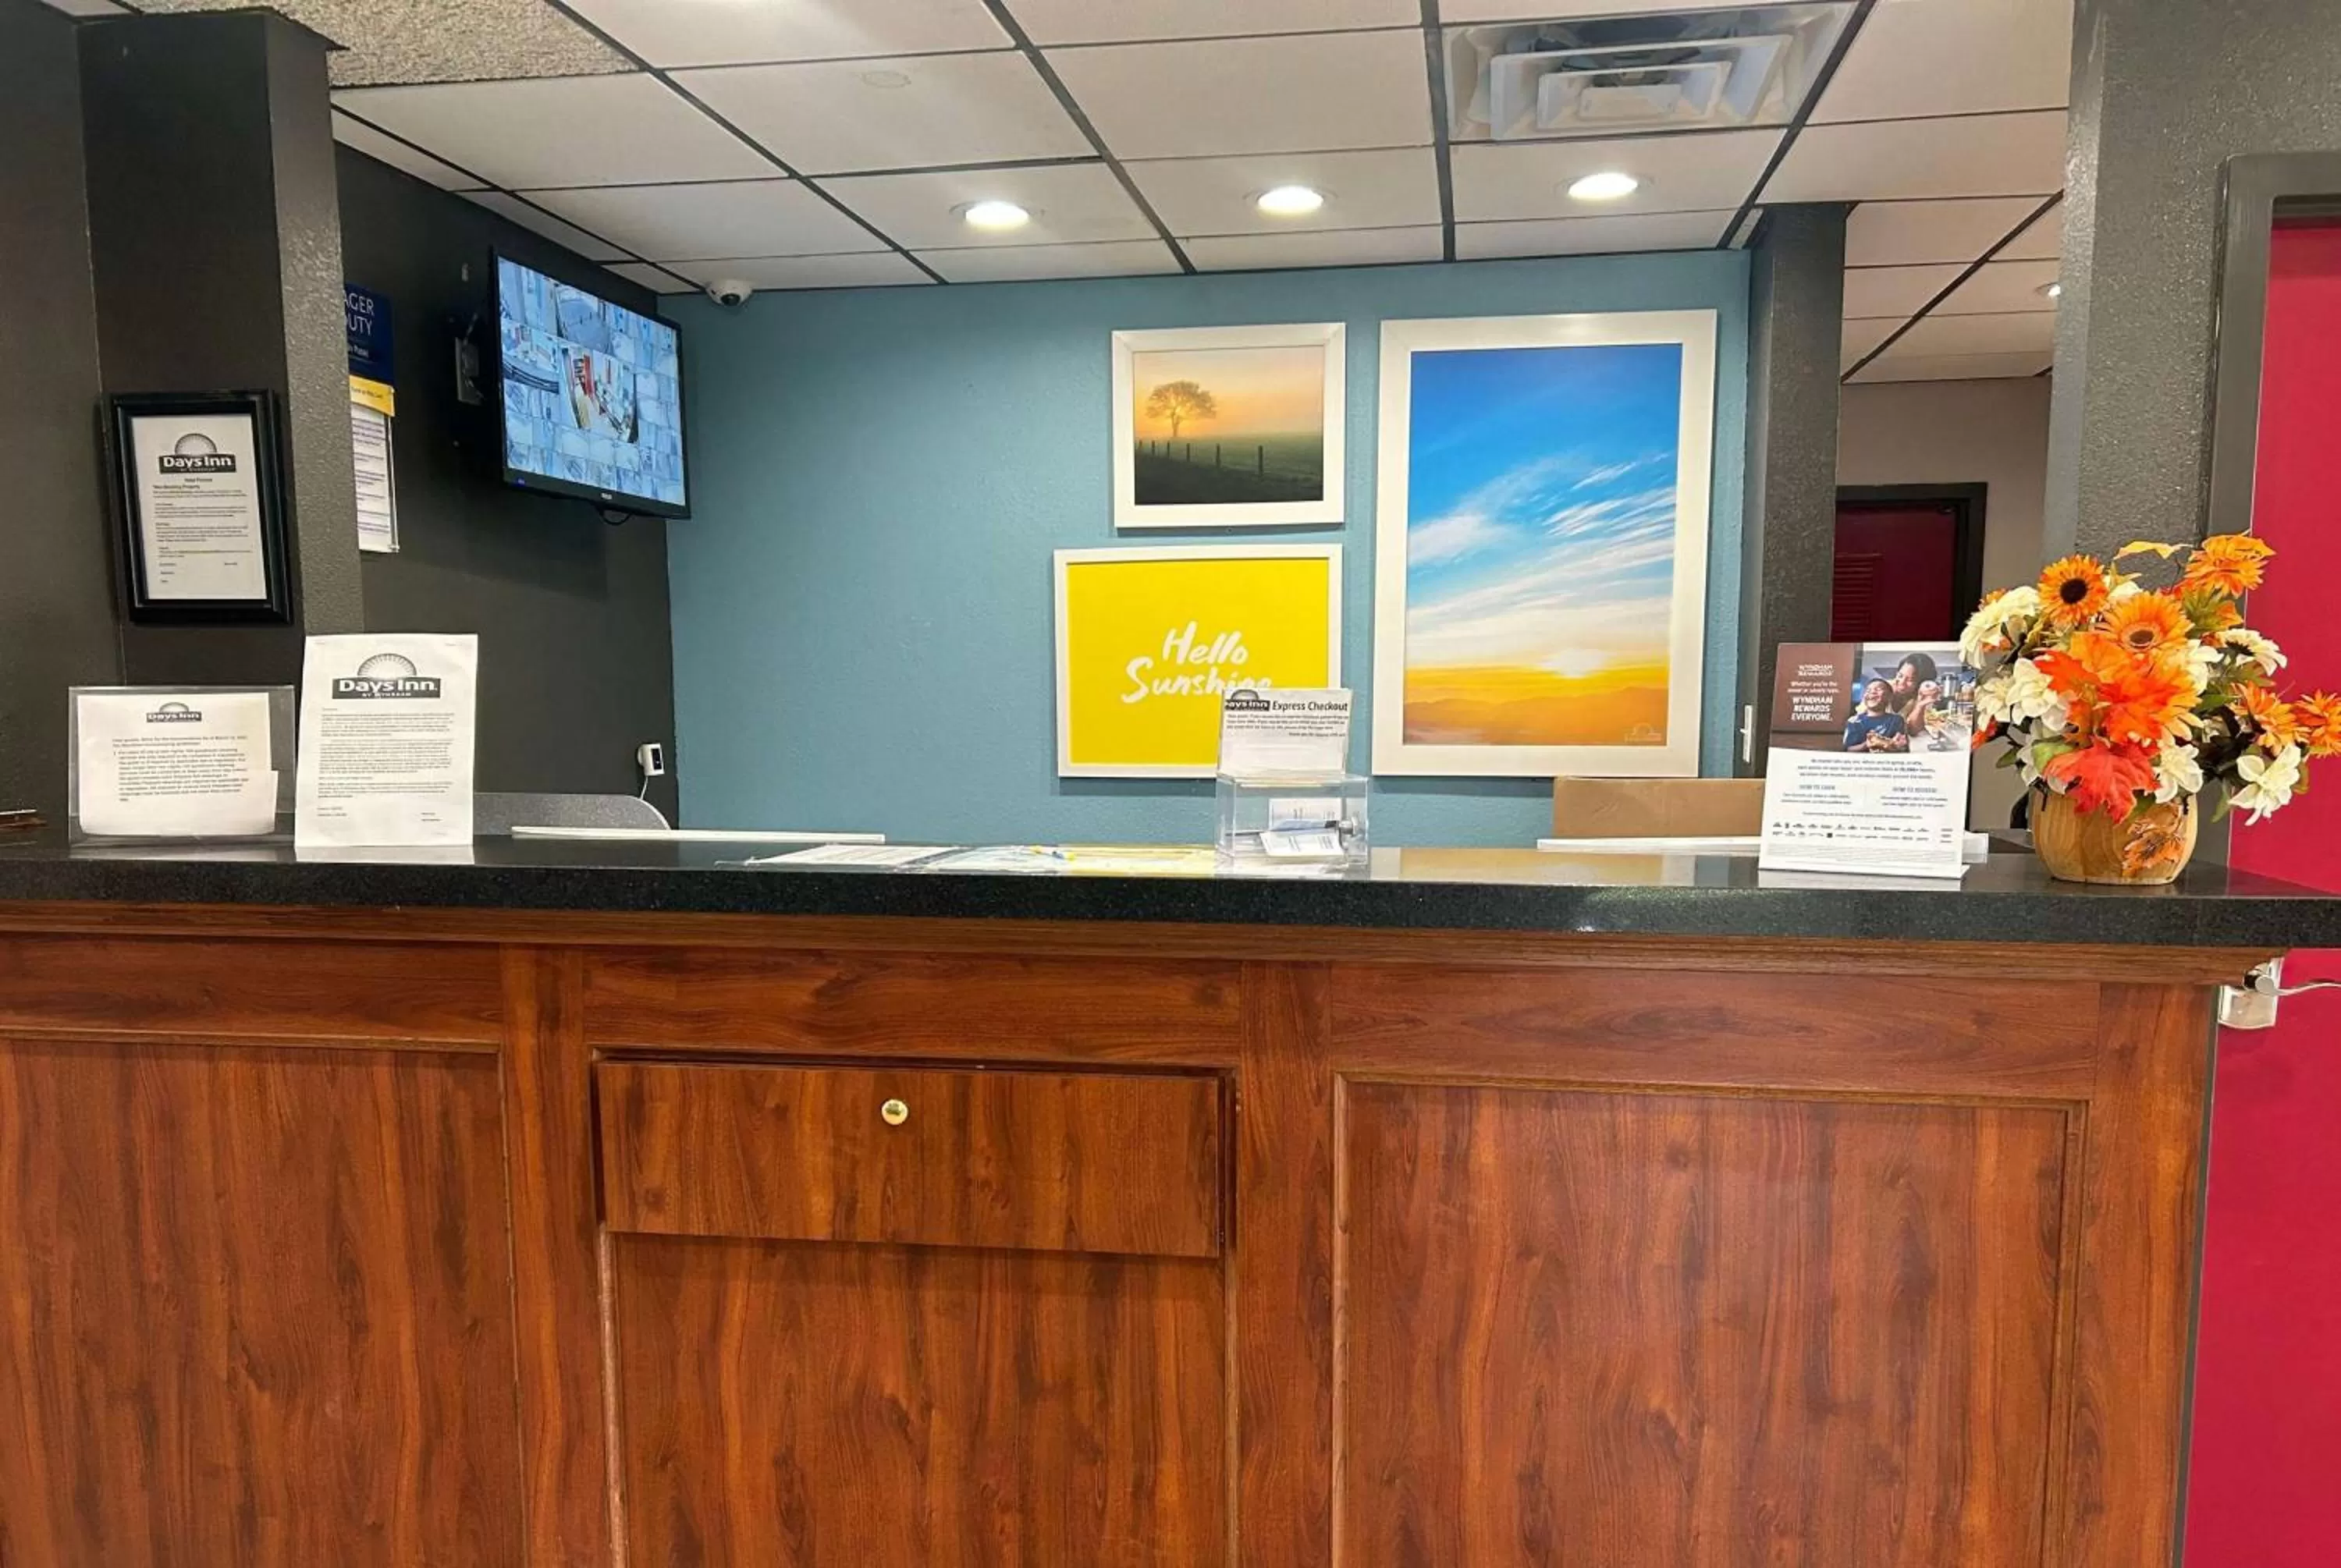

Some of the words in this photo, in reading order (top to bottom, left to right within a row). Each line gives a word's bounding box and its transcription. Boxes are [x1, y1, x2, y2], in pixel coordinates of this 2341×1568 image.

[344, 314, 372, 335] UTY
[163, 456, 202, 469] Days
[204, 456, 232, 466] Inn
[1162, 621, 1249, 665] Hello
[339, 680, 394, 693] Days
[398, 679, 435, 690] Inn
[1272, 701, 1305, 711] Express
[1308, 701, 1348, 711] Checkout
[1792, 696, 1833, 704] WYNDHAM
[1791, 712, 1833, 721] EVERYONE.
